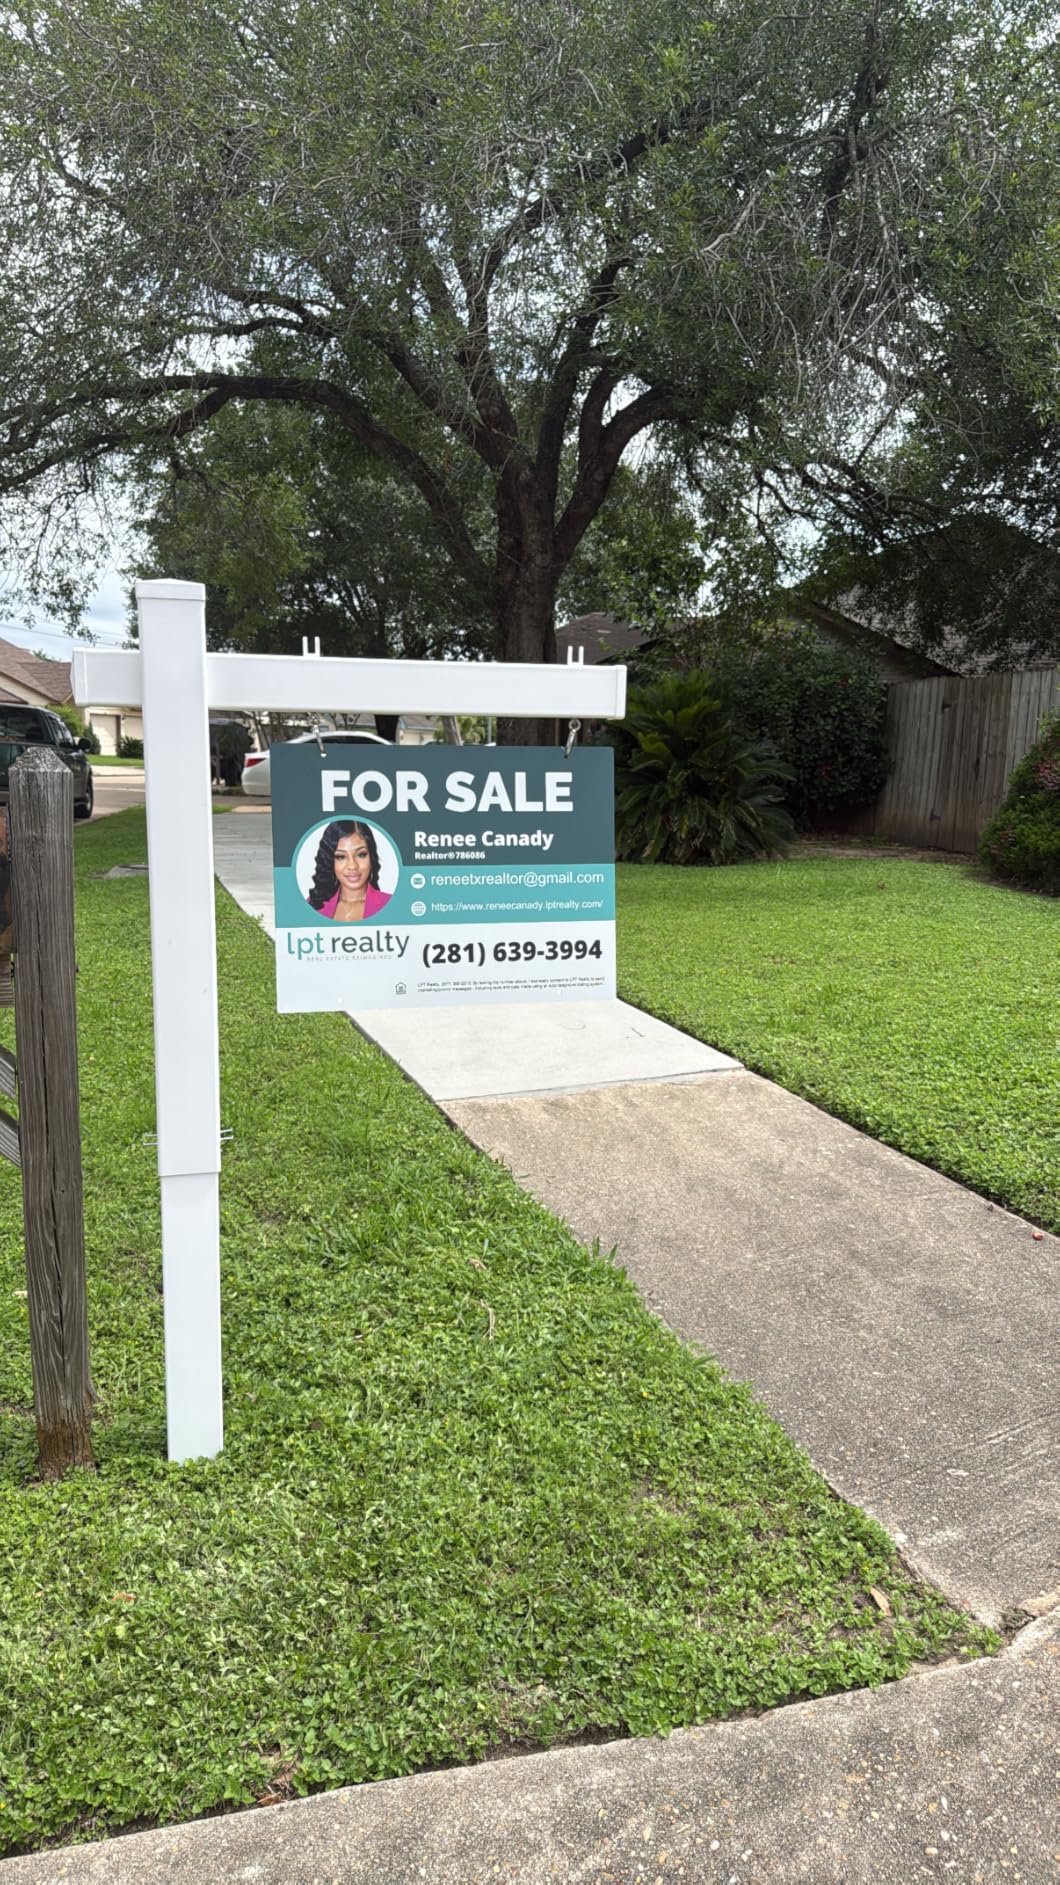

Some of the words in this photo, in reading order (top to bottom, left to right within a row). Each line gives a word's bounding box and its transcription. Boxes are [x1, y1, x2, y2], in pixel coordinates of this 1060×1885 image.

[321, 770, 431, 812] FOR
[445, 771, 574, 812] SALE
[414, 831, 475, 847] Renee
[481, 830, 553, 850] Canady
[430, 871, 604, 887] reneetxrealtor@gmail.com
[430, 900, 604, 913] https://www.reneecanady.lptrealty.com/
[287, 932, 325, 960] lpt
[332, 930, 410, 958] realty
[422, 942, 486, 968] (281)
[492, 939, 603, 962] 639-3994
